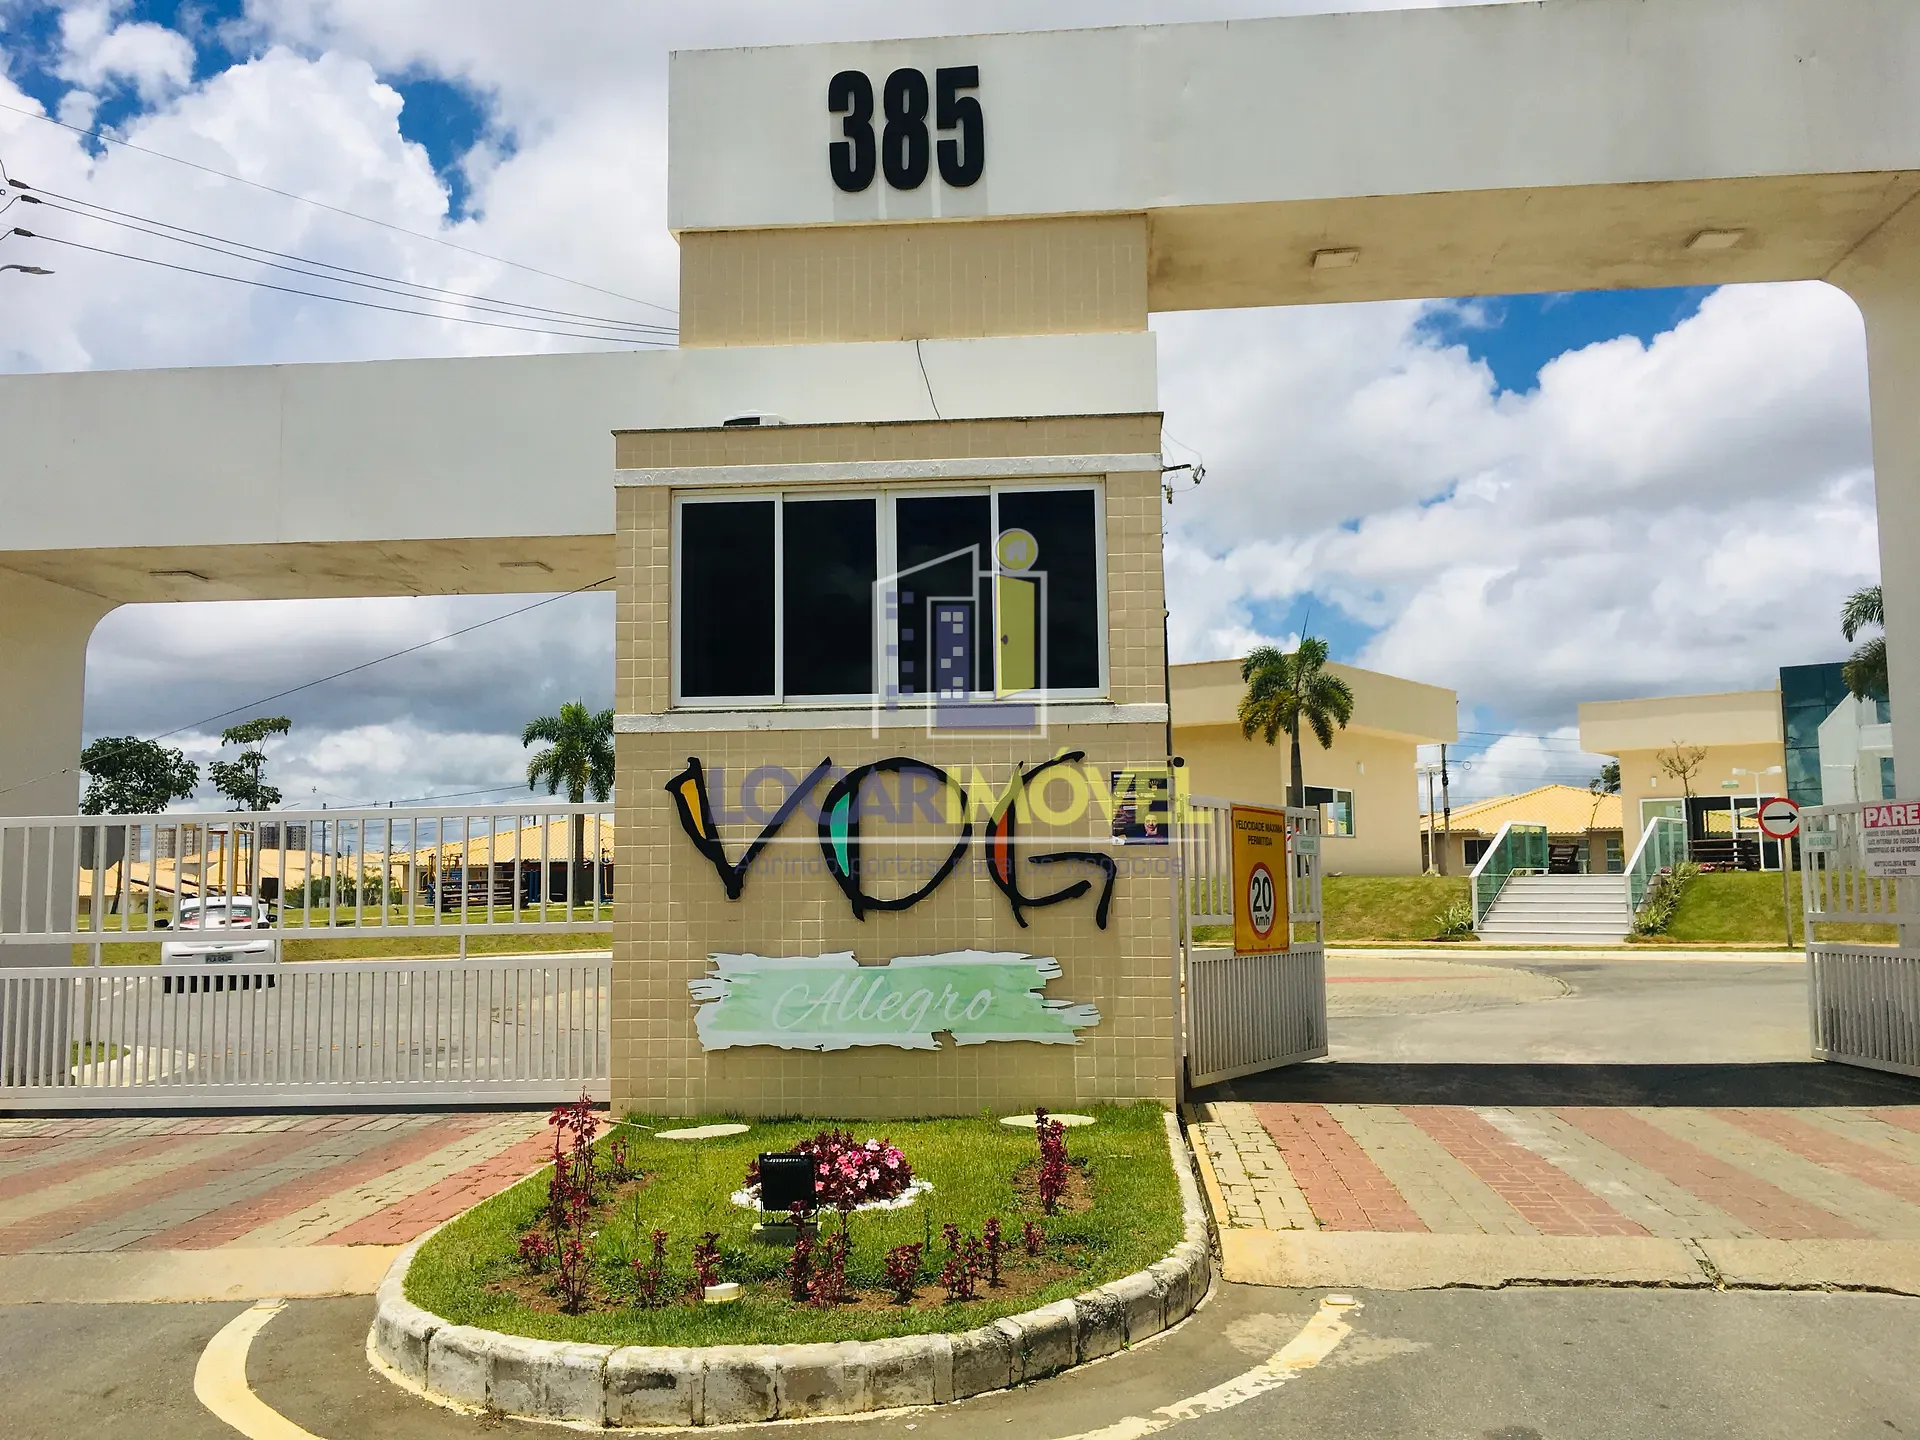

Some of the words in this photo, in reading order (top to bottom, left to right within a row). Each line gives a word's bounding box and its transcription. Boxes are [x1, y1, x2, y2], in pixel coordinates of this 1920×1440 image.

[828, 65, 984, 192] 385
[1235, 819, 1264, 831] VELOCIDADE
[1865, 804, 1920, 827] PARE
[1252, 876, 1272, 912] 20
[771, 973, 997, 1034] Allegro
